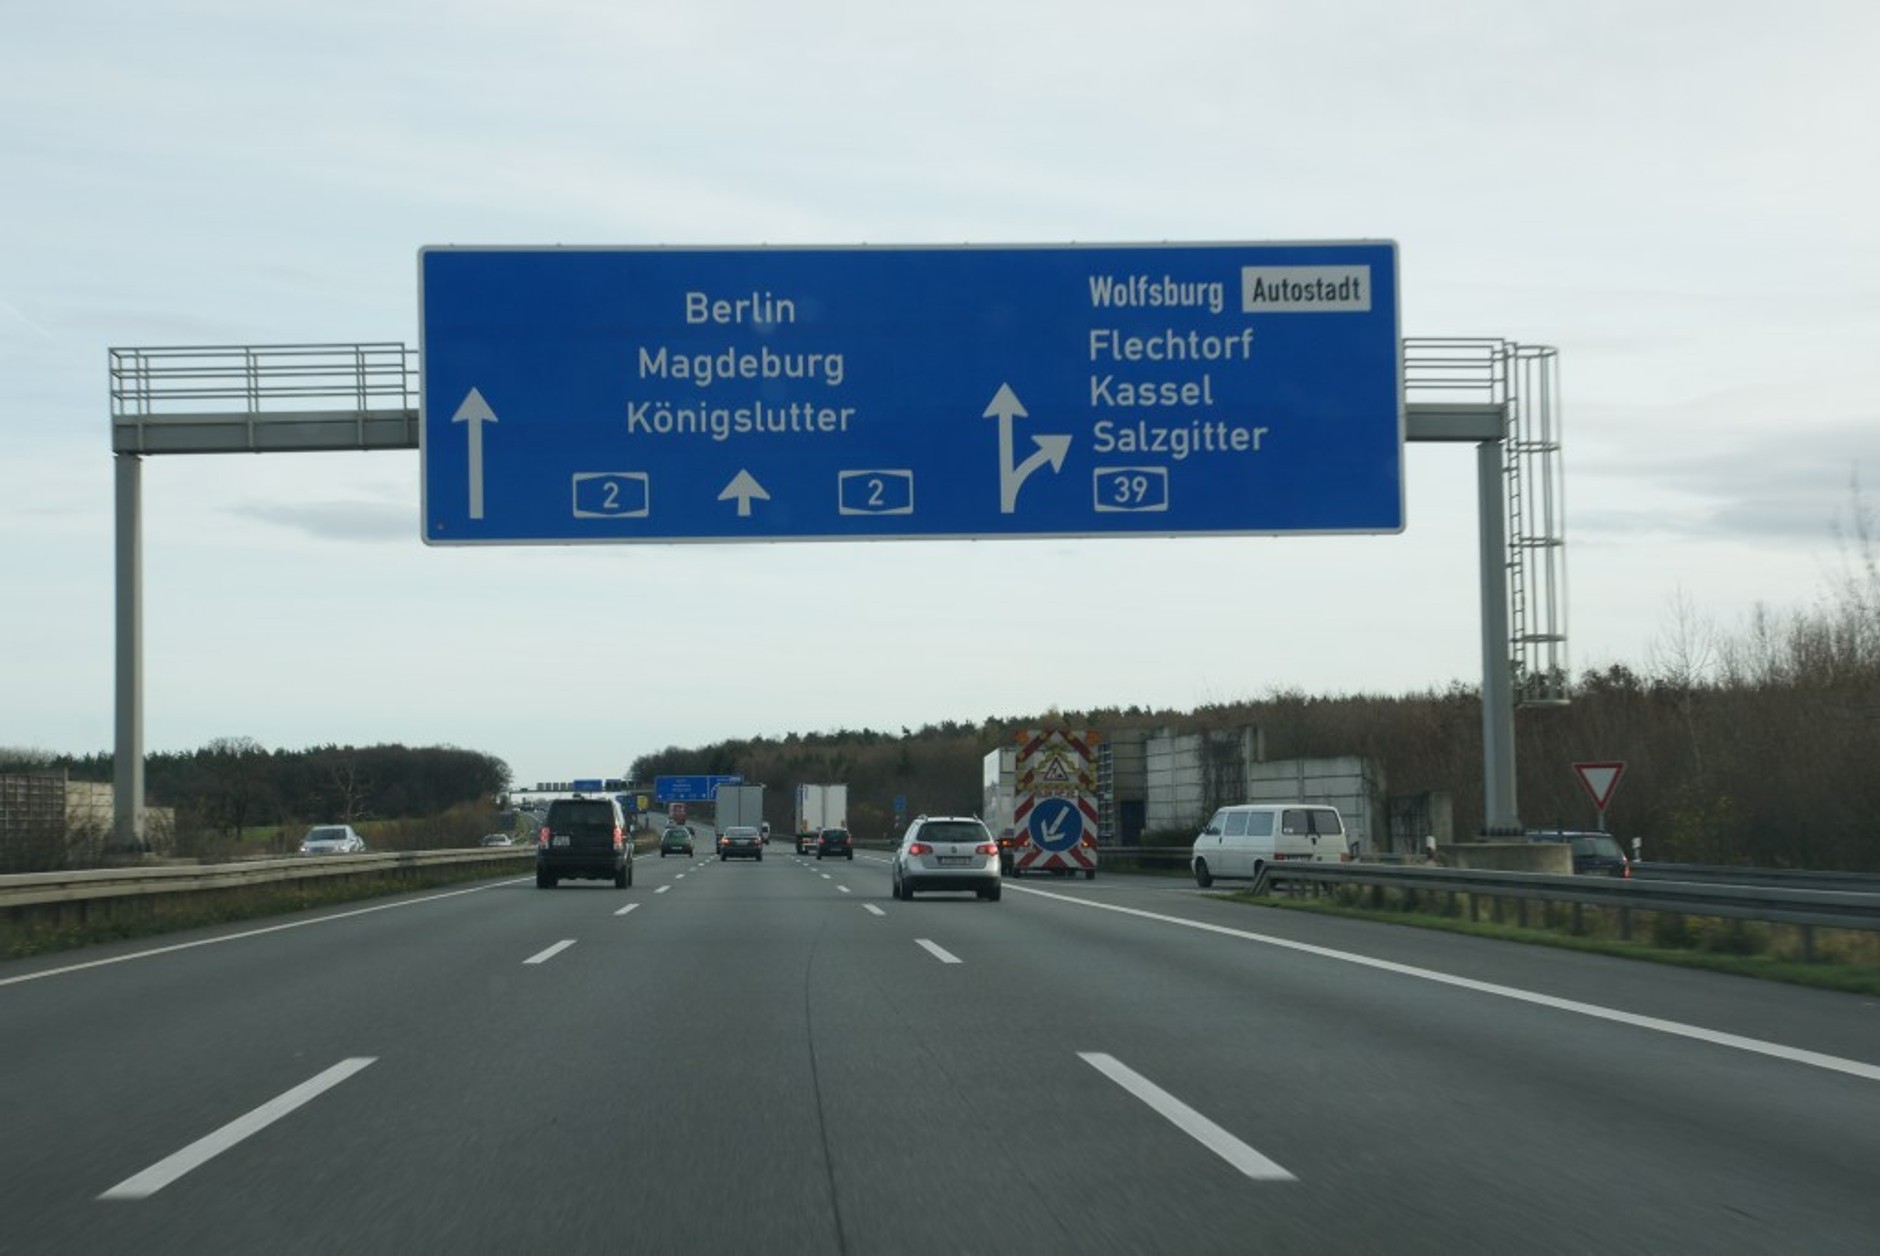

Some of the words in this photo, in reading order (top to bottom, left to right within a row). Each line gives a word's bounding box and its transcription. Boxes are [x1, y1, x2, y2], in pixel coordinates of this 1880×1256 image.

[686, 292, 795, 323] Berlin
[1089, 276, 1223, 314] Wolfsburg
[1252, 276, 1361, 303] Autostadt
[1090, 328, 1252, 361] Flechtorf
[639, 347, 844, 386] Magdeburg
[1091, 375, 1213, 406] Kassel
[628, 402, 855, 440] Königslutter
[1094, 421, 1268, 459] Salzgitter
[603, 481, 619, 508] 2
[868, 478, 885, 506] 2
[1115, 476, 1148, 502] 39
